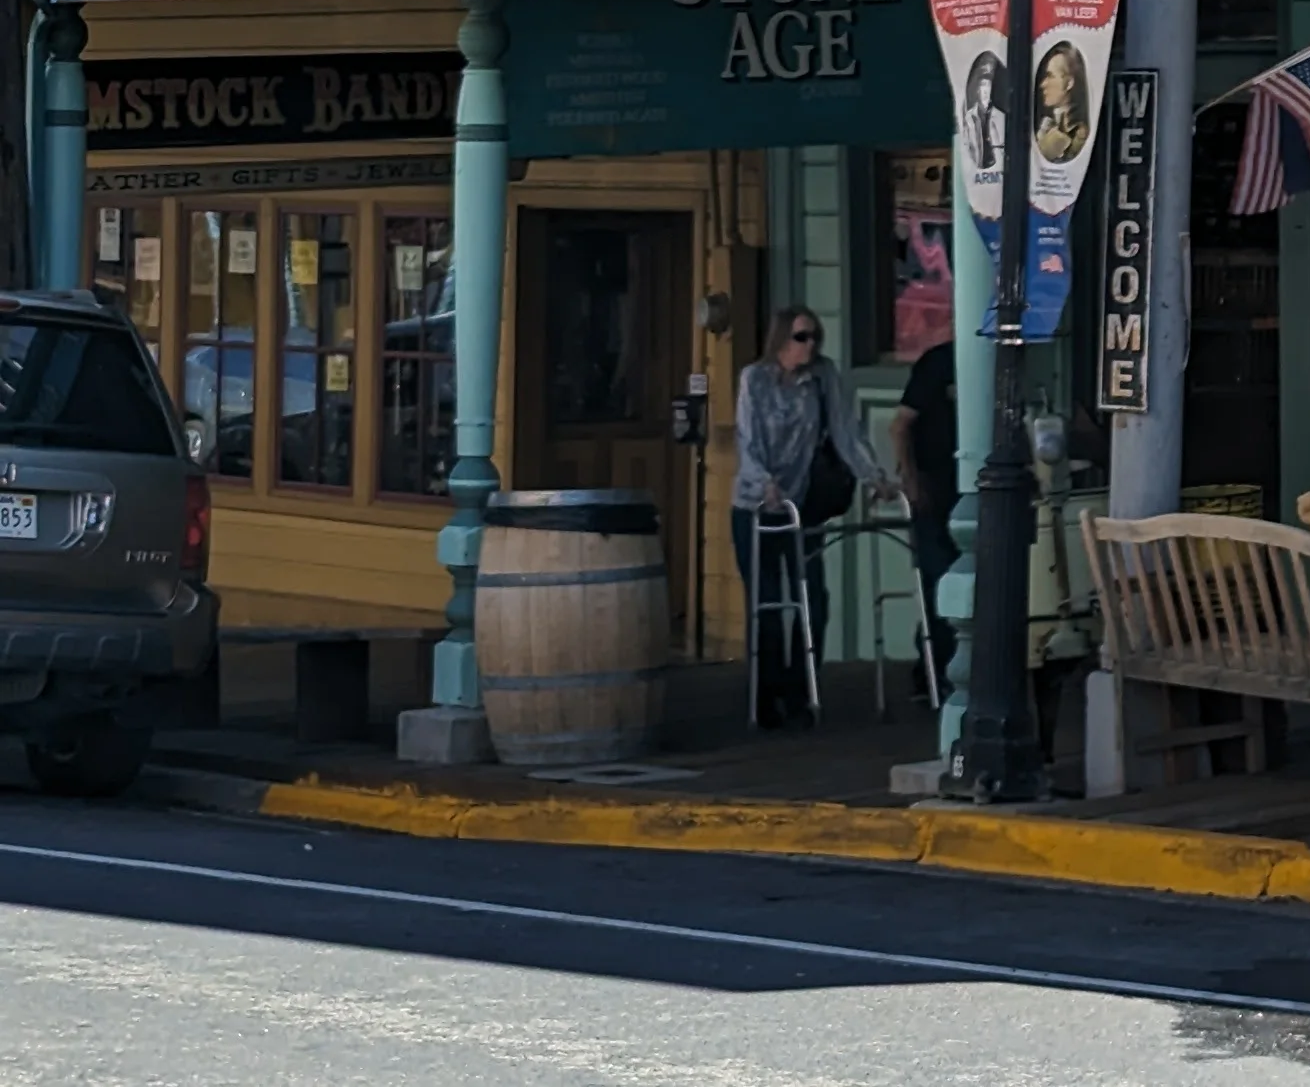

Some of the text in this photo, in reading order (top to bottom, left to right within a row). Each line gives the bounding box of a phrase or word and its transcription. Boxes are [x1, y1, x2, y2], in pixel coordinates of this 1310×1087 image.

[1055, 6, 1073, 18] VAN
[719, 9, 857, 81] AGE
[87, 76, 288, 131] MSTOCK
[89, 171, 203, 192] ATHER
[231, 166, 319, 186] GIFTS
[1106, 80, 1153, 398] WELCOME
[0, 508, 33, 528] 853
